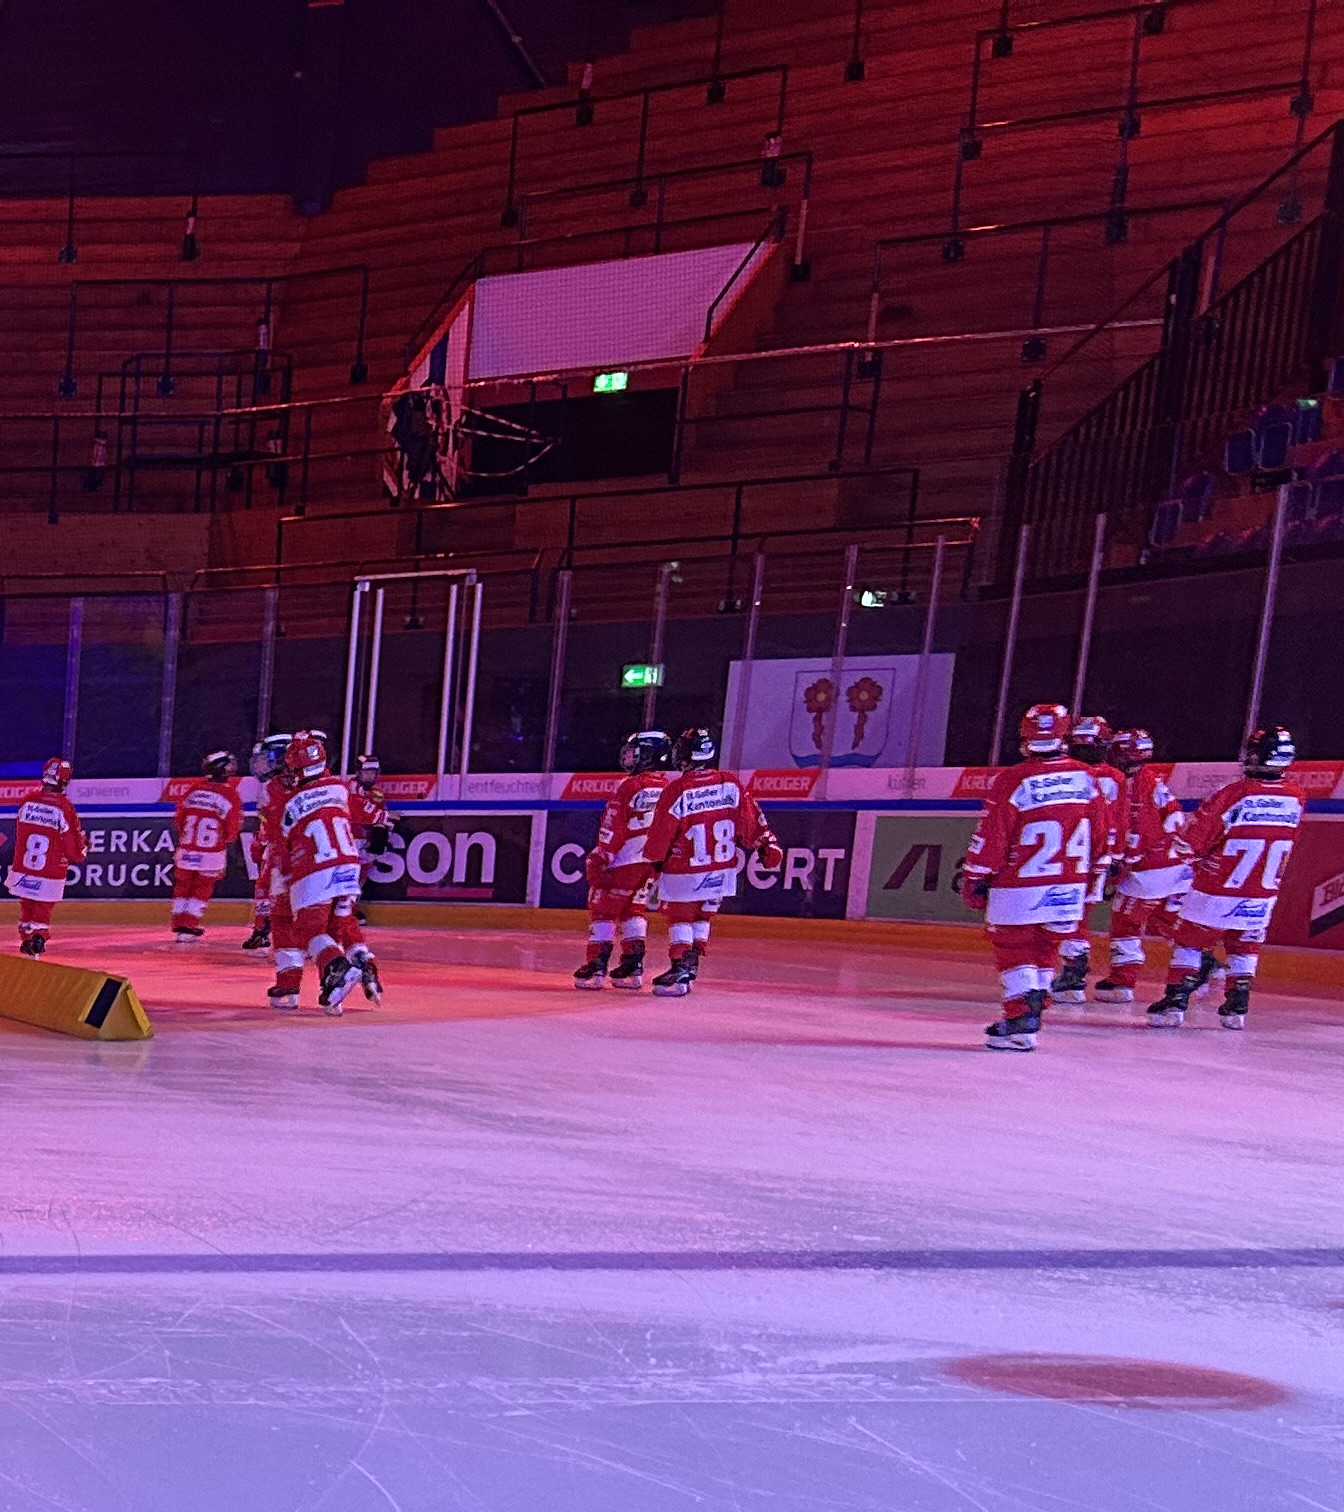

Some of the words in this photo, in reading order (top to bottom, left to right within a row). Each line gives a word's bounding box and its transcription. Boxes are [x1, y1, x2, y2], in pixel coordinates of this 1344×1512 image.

[22, 833, 50, 871] 8
[179, 815, 220, 848] 16
[684, 818, 736, 867] 18
[1018, 818, 1092, 878] 24
